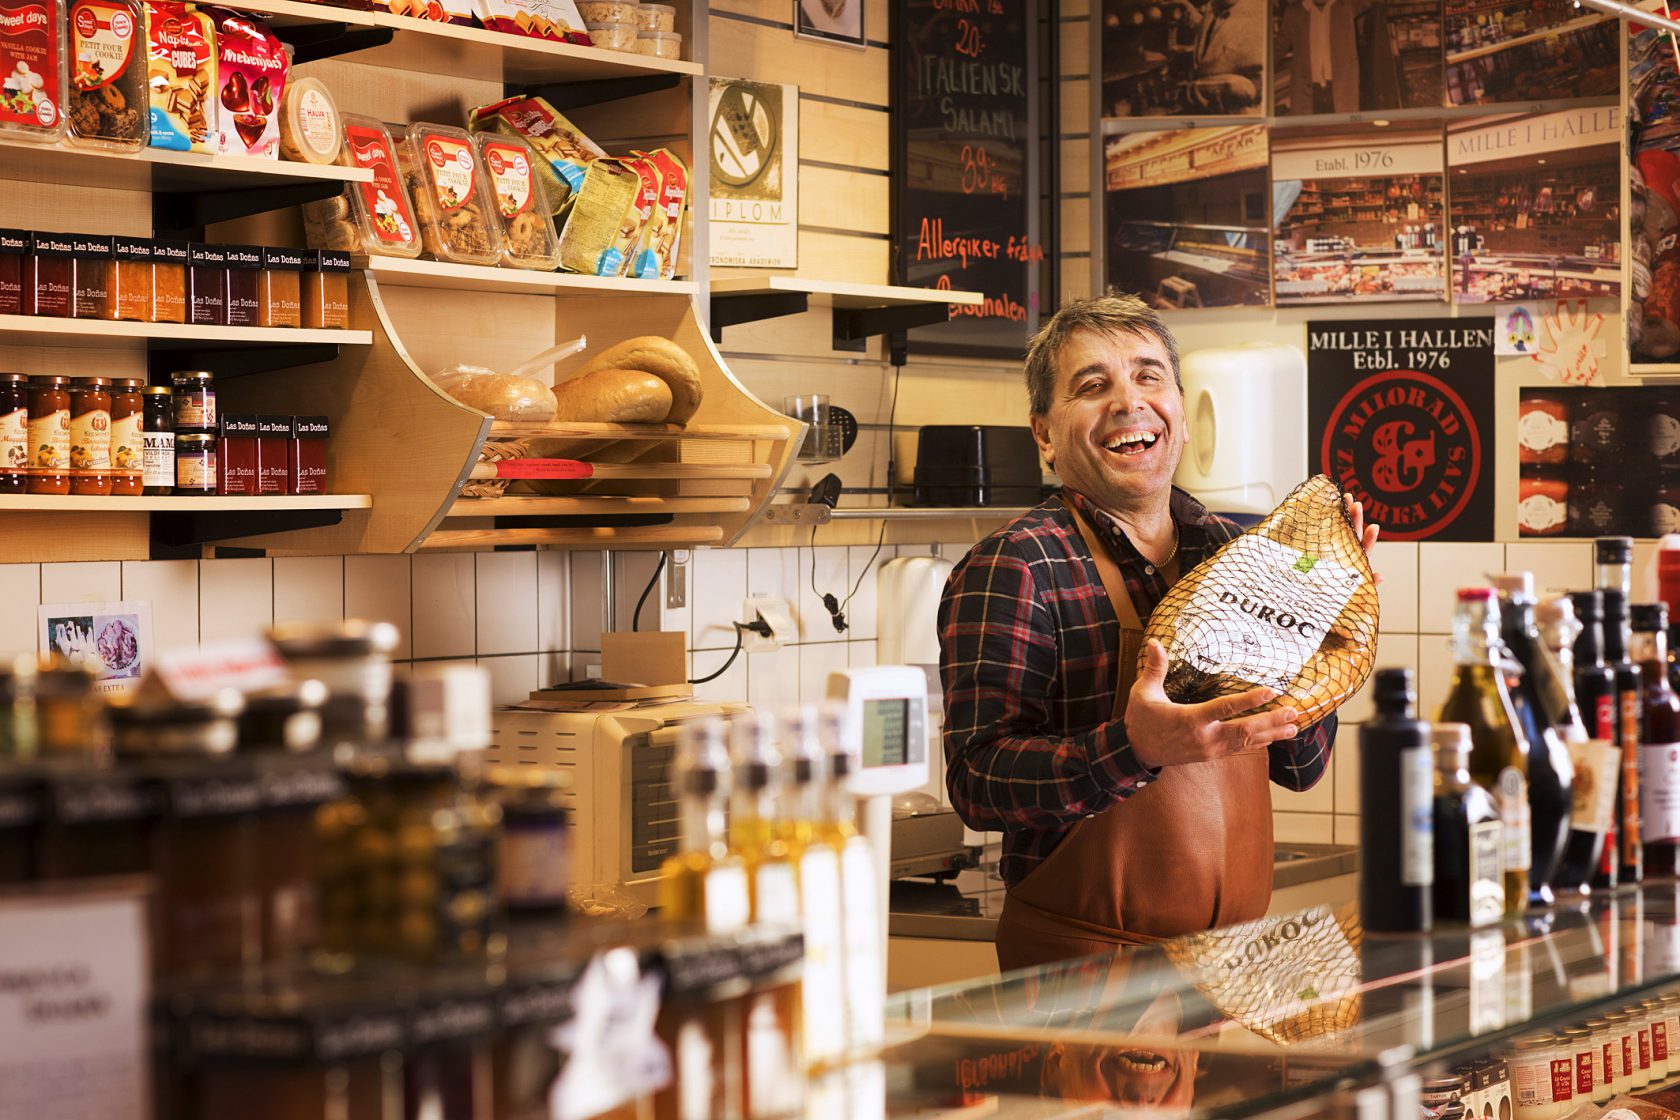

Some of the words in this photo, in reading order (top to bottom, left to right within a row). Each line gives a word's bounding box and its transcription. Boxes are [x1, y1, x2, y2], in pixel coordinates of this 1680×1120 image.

[26, 11, 48, 24] days
[10, 52, 24, 60] WITH
[26, 53, 38, 61] JAM
[26, 45, 48, 56] COOKIE
[80, 40, 101, 50] PETIT
[102, 43, 123, 53] FOUR
[95, 50, 124, 60] COOKIE
[172, 50, 197, 70] CUBES
[919, 54, 1026, 98] ITALIENSK
[307, 108, 326, 118] HALVA
[941, 96, 1016, 142] SALAMI
[1458, 128, 1518, 154] MILLE
[1526, 125, 1531, 144] I
[1315, 158, 1350, 172] Etabl.
[1354, 151, 1394, 169] 1976
[713, 201, 782, 220] IPLOM
[917, 217, 1000, 270] Allergiker
[710, 256, 746, 264] RONOMISKA
[1311, 331, 1380, 350] MILLE
[1384, 330, 1393, 349] I
[1400, 328, 1494, 349] HALLEN
[1354, 350, 1399, 370] Etbl.
[1408, 351, 1450, 370] 1976
[1343, 386, 1460, 441] MILORAD
[1218, 590, 1316, 639] DUROC
[103, 684, 125, 693] EXTRA
